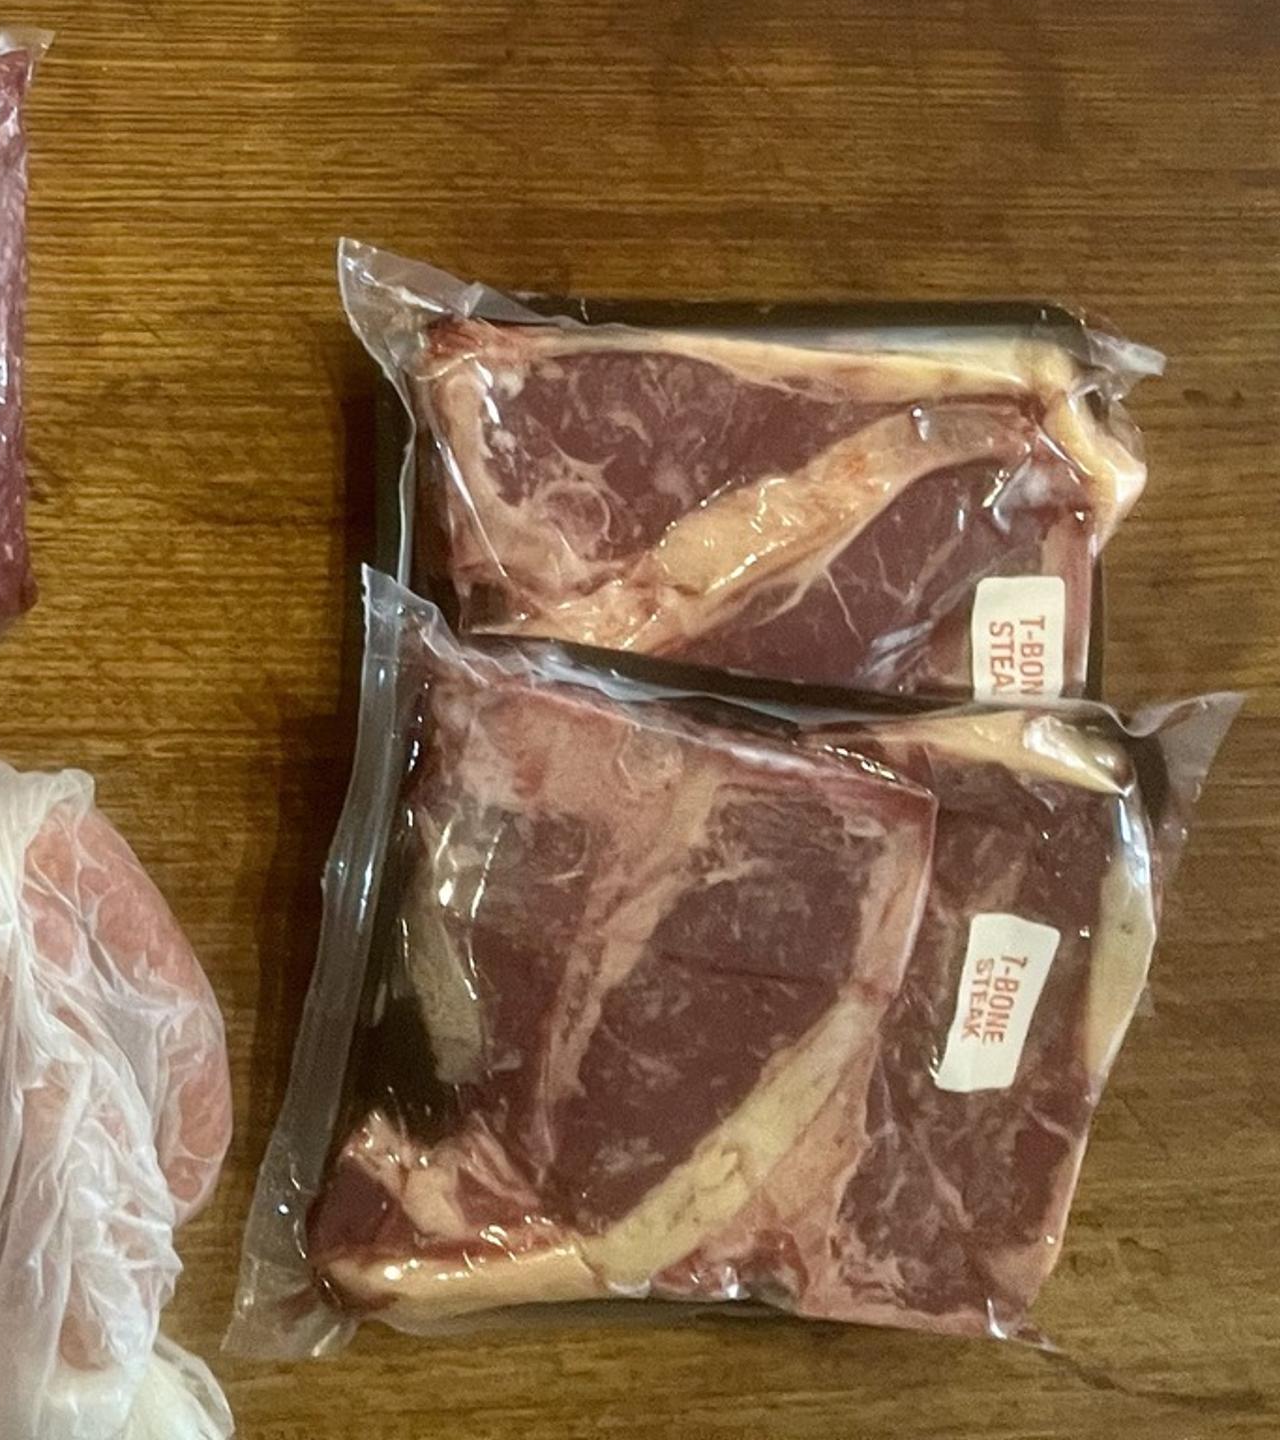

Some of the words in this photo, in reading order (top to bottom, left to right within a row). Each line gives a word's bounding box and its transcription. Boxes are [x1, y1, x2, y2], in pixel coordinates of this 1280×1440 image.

[989, 620, 1015, 695] STEA
[1020, 615, 1046, 695] T-BON
[961, 957, 995, 1042] STEAK
[983, 954, 1029, 1046] T-BONE
